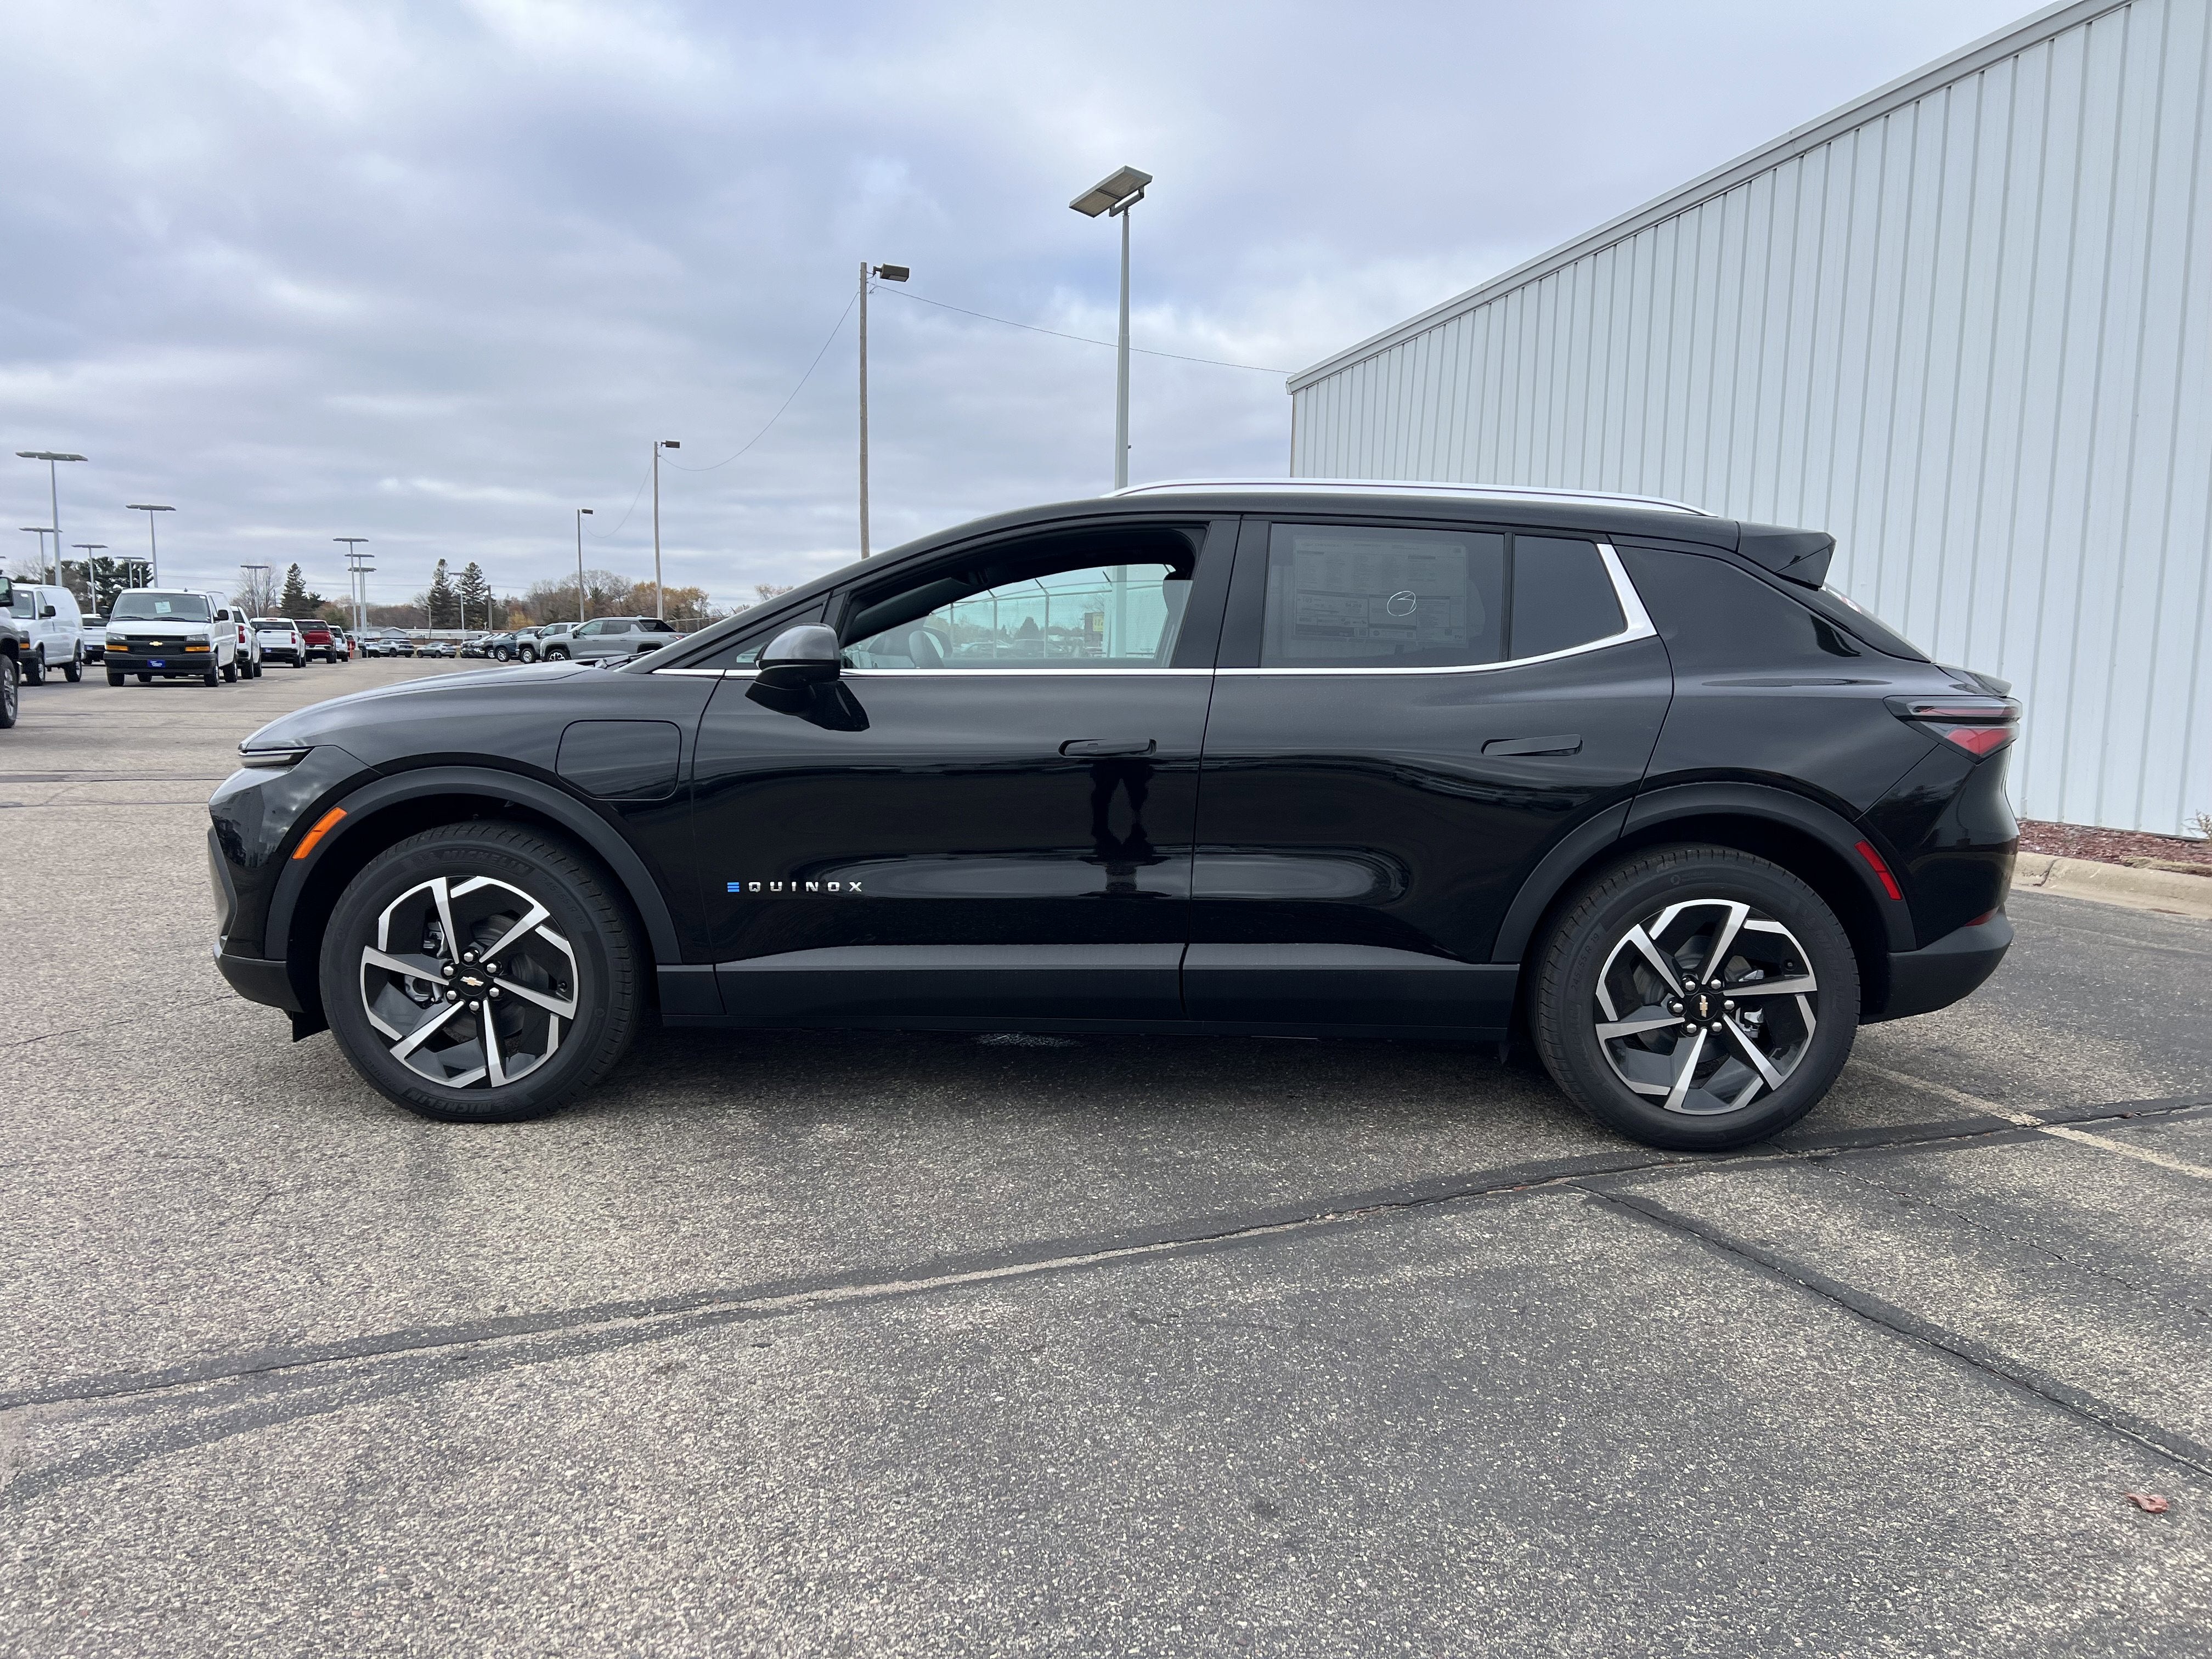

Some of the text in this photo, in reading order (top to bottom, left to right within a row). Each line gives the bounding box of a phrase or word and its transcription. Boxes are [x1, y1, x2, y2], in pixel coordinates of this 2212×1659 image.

[442, 850, 530, 876] MICHELIN
[538, 875, 571, 905] 245/55
[574, 916, 585, 924] 19
[727, 881, 862, 893] EQUINOX
[1571, 932, 1600, 991] 245/55 R 19
[406, 1090, 492, 1113] MICHELIN
